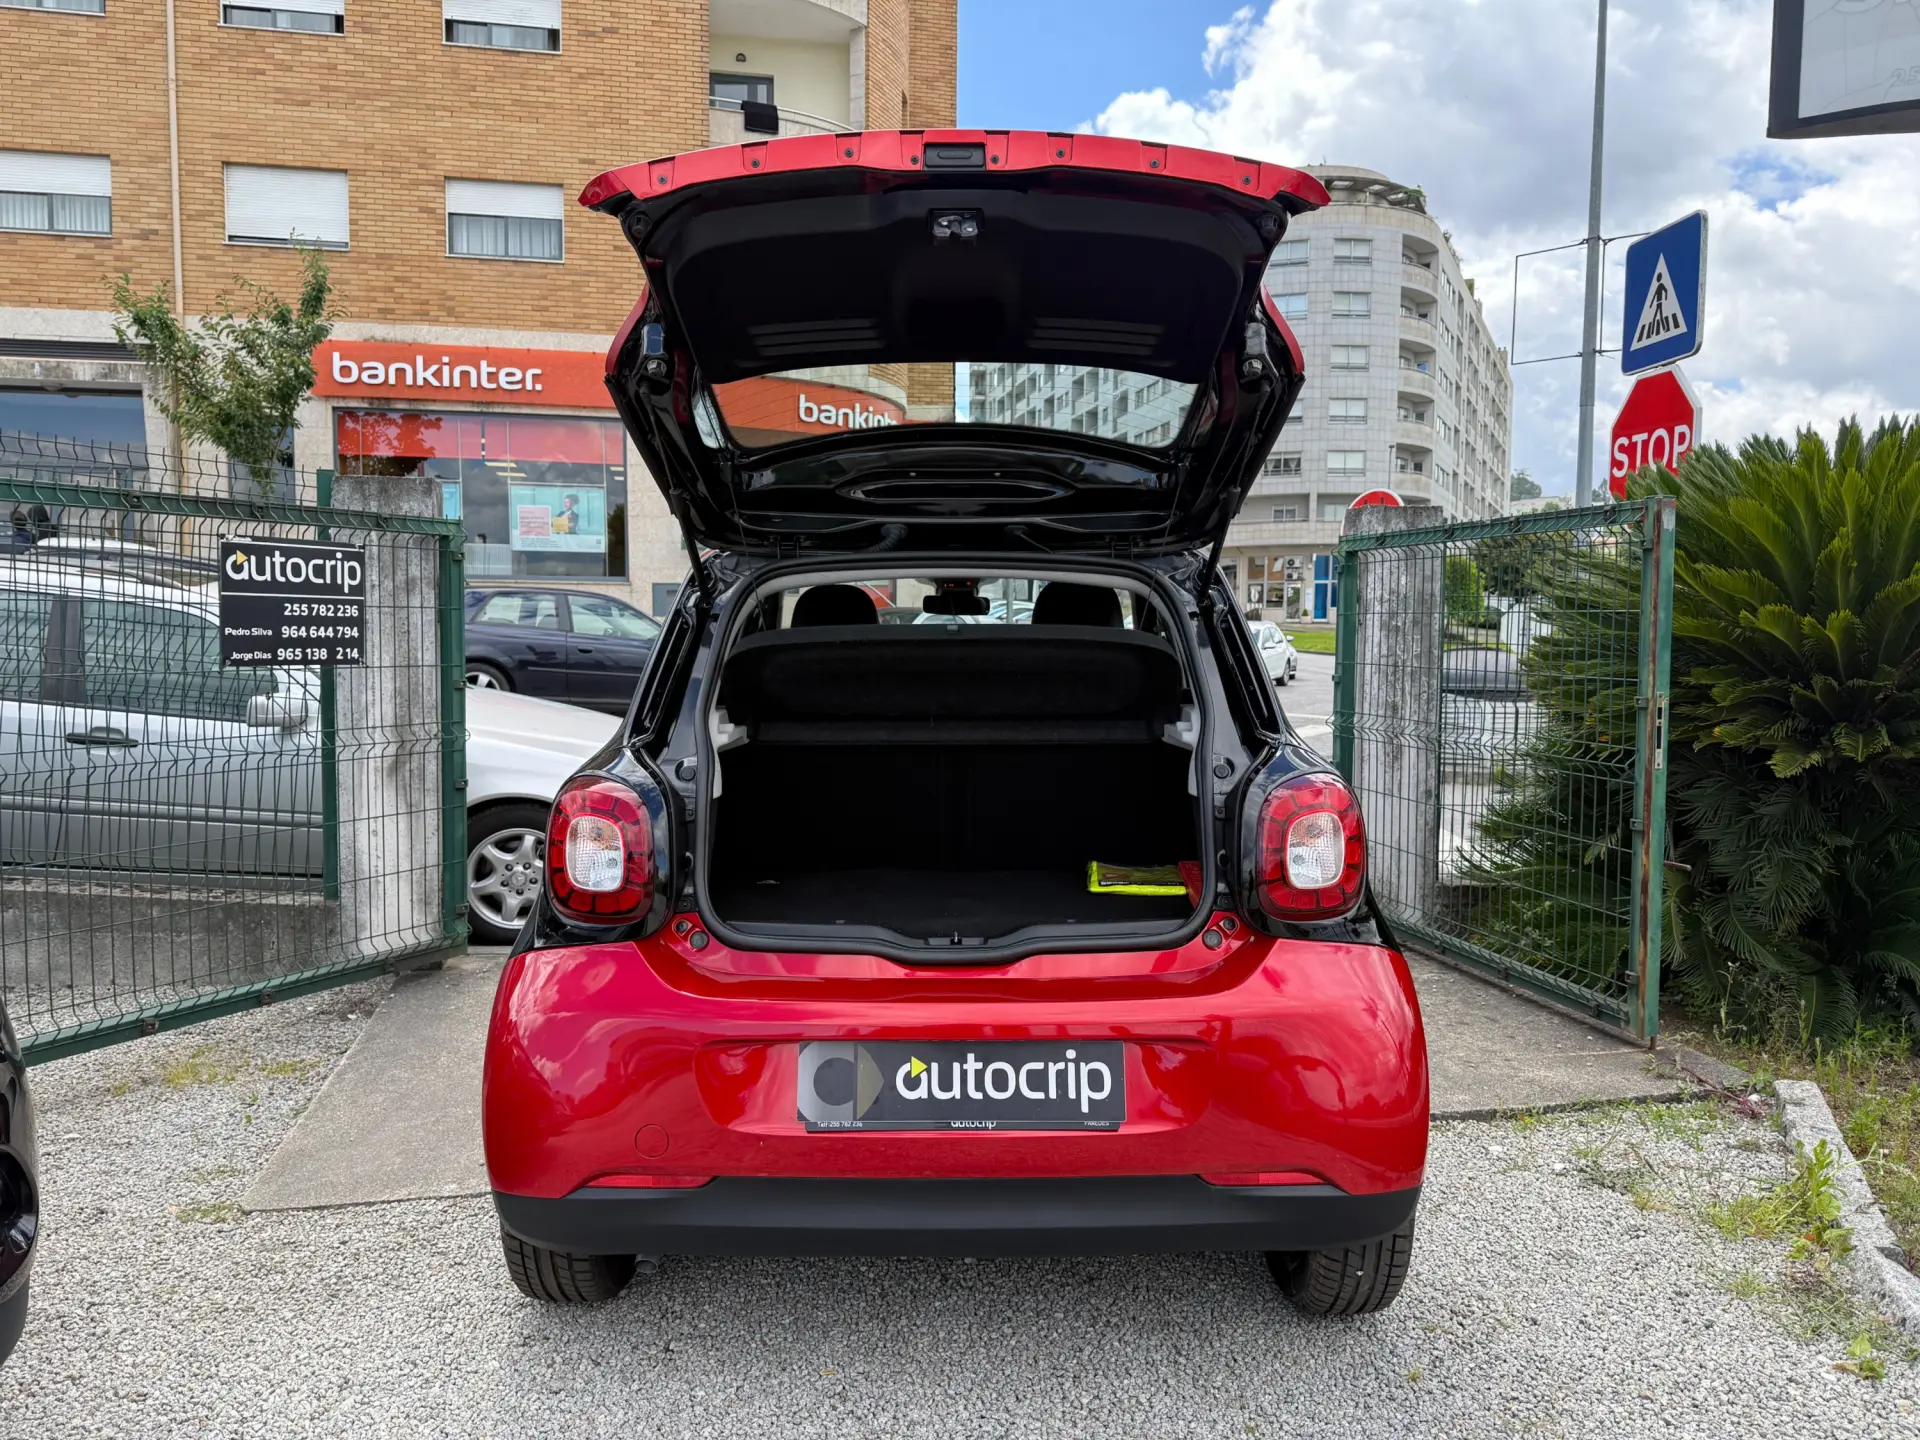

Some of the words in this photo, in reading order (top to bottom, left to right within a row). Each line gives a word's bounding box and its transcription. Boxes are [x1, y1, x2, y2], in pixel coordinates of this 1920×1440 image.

[1612, 424, 1691, 478] STOP
[225, 549, 362, 594] autocrip
[283, 603, 309, 616] 255
[311, 604, 335, 617] 782
[336, 605, 359, 617] 236
[224, 627, 251, 636] Pedro
[251, 627, 273, 637] Silva
[281, 625, 307, 639] 964
[309, 626, 335, 639] 644
[336, 626, 360, 639] 794
[230, 651, 253, 661] Jorge
[254, 651, 272, 660] Dias
[277, 648, 302, 661] 965
[305, 648, 328, 660] 138
[335, 647, 359, 660] 214
[896, 1049, 1111, 1113] autocrip
